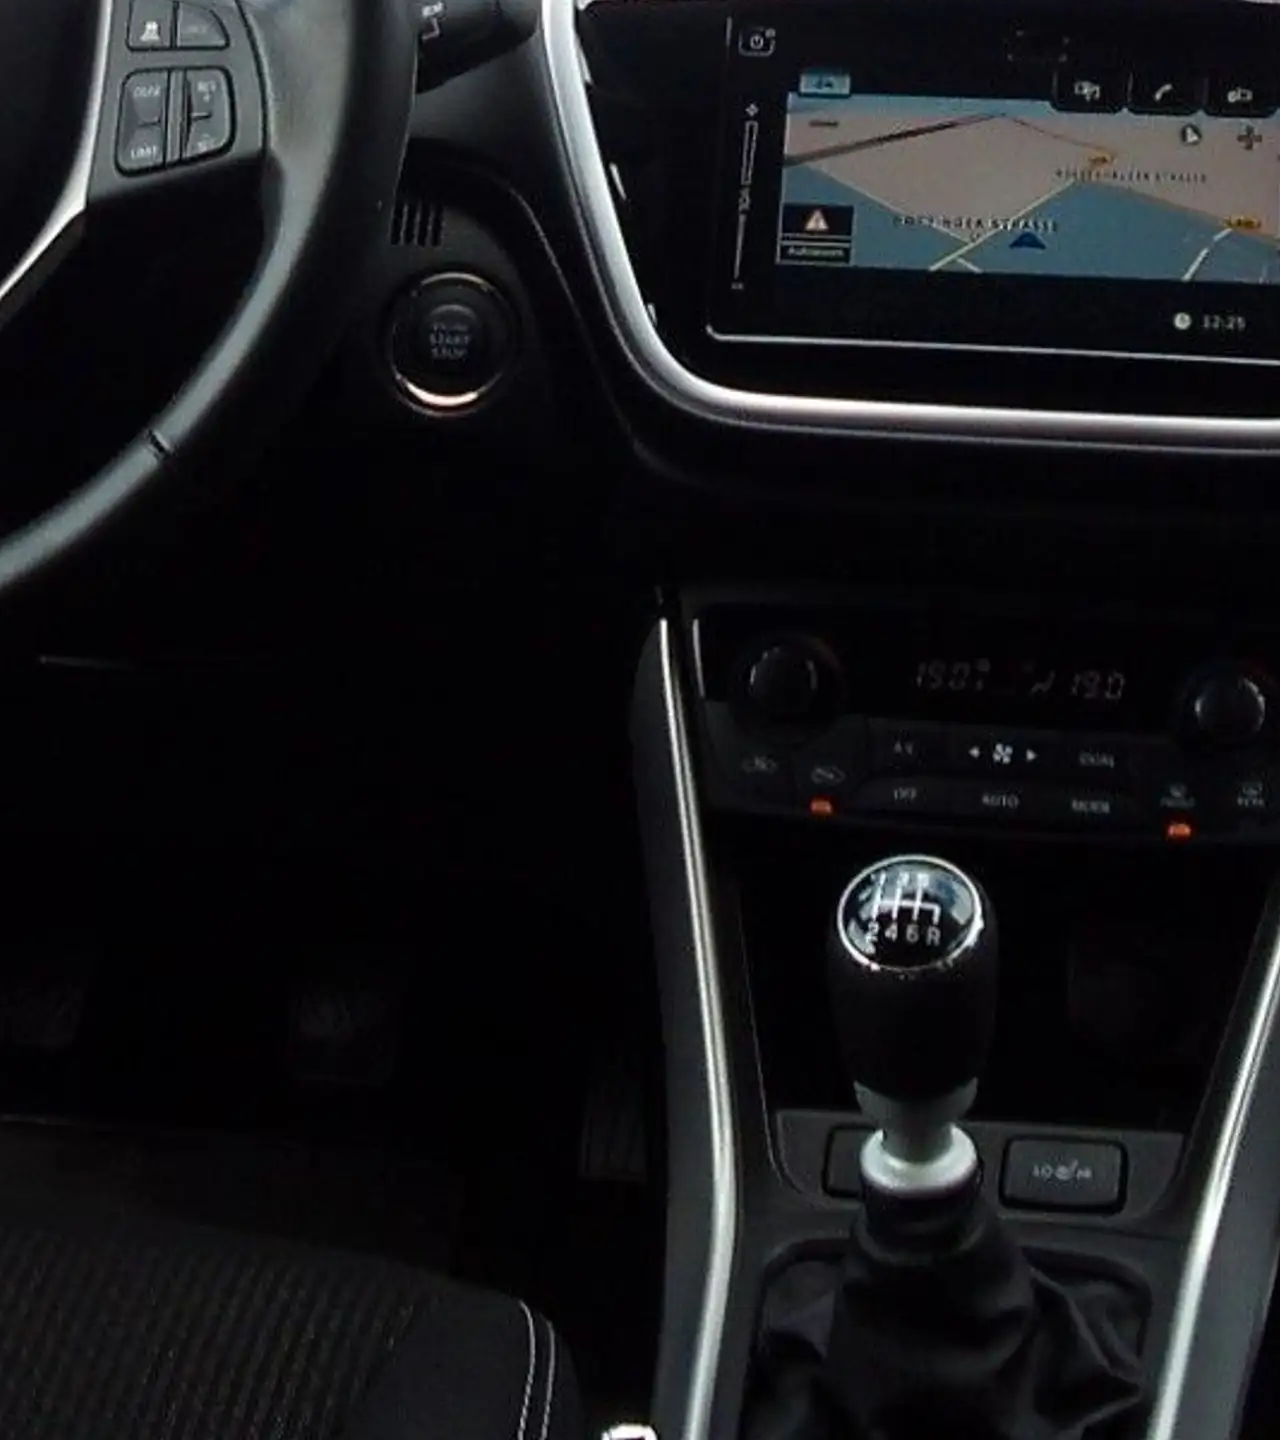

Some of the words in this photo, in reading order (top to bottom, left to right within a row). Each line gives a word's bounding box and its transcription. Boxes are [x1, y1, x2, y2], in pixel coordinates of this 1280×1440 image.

[884, 923, 898, 941] 4
[906, 923, 920, 943] 6
[926, 926, 941, 946] R
